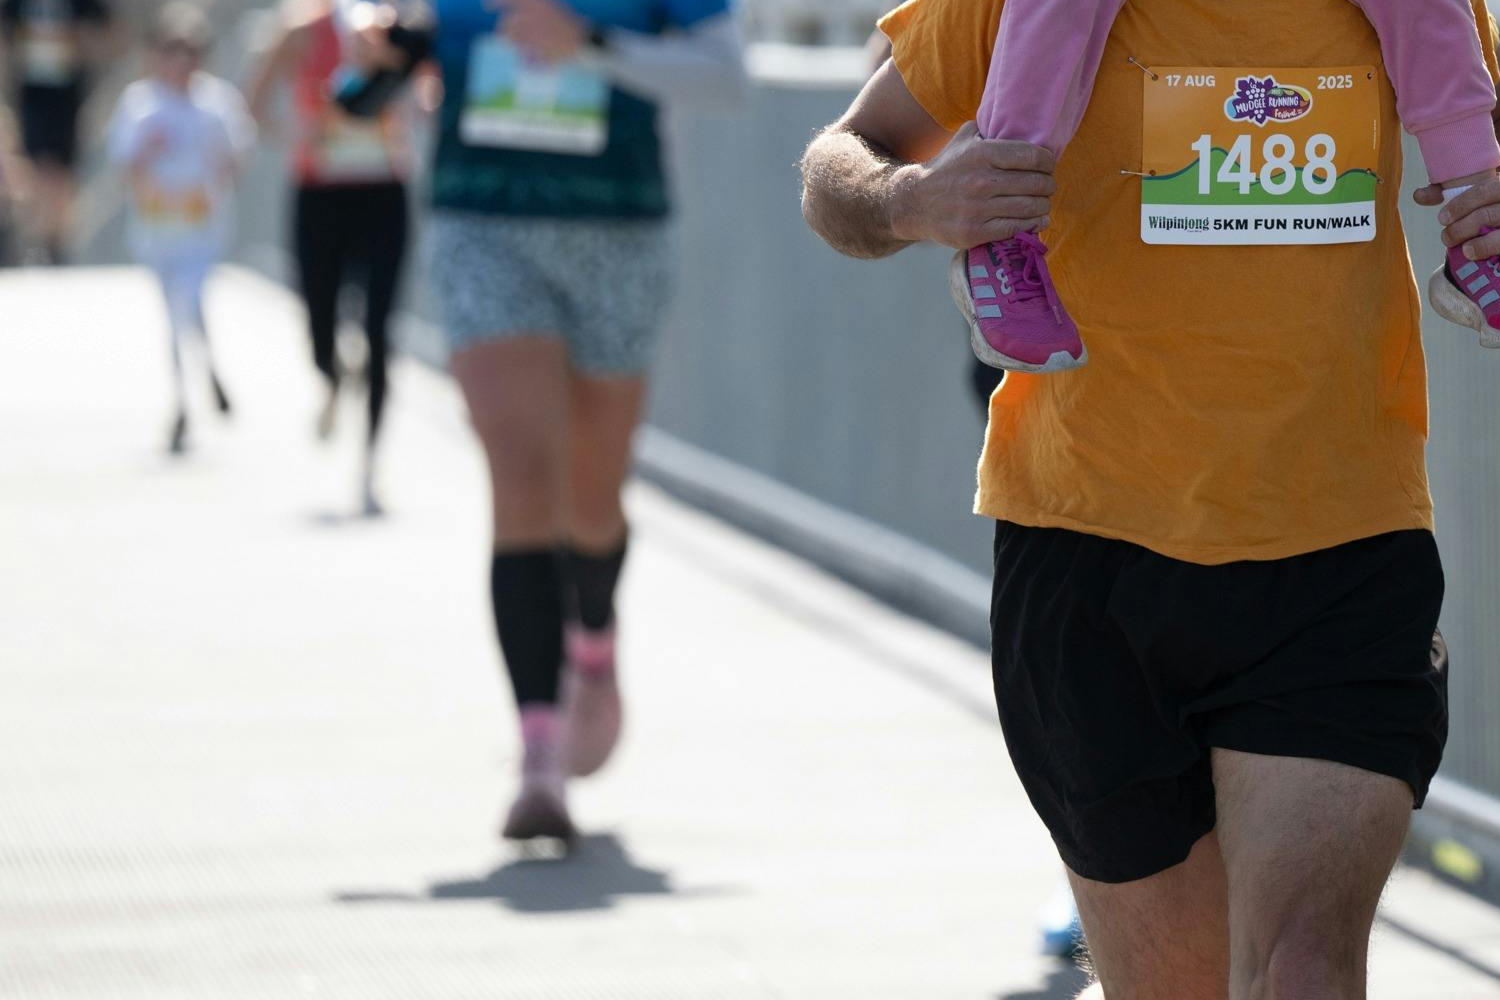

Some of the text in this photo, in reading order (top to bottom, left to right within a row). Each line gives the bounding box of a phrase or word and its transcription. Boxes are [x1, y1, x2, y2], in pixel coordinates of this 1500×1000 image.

[1165, 74, 1216, 87] 17 AUG
[1317, 75, 1353, 90] 2025
[1235, 96, 1299, 113] MUDGEE RUNNING
[1191, 133, 1337, 195] 1488
[1149, 214, 1370, 231] Wilpinjong 5KM FUN RUN/WALK
